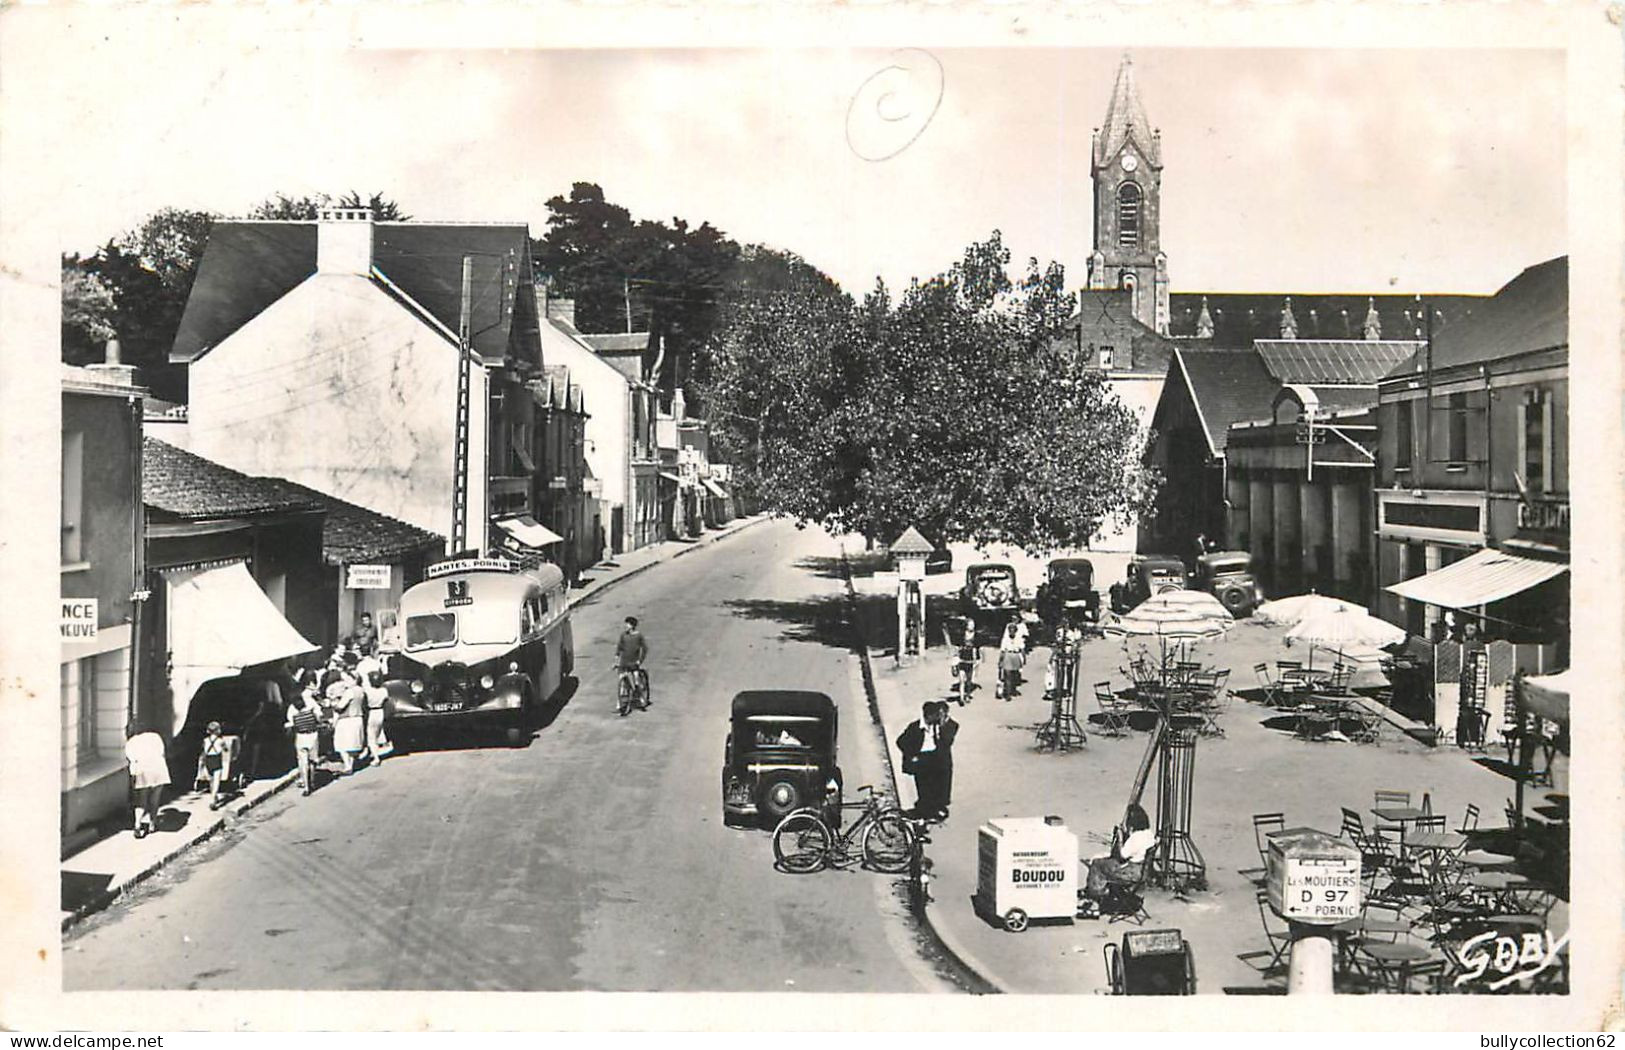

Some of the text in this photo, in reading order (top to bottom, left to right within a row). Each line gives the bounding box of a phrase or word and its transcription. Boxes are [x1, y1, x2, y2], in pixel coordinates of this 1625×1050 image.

[62, 604, 94, 619] NCE
[1012, 868, 1065, 883] BOUDOU
[1304, 876, 1357, 887] MOUTIERS
[1301, 889, 1349, 903] D 97
[1315, 905, 1356, 916] PORNIC
